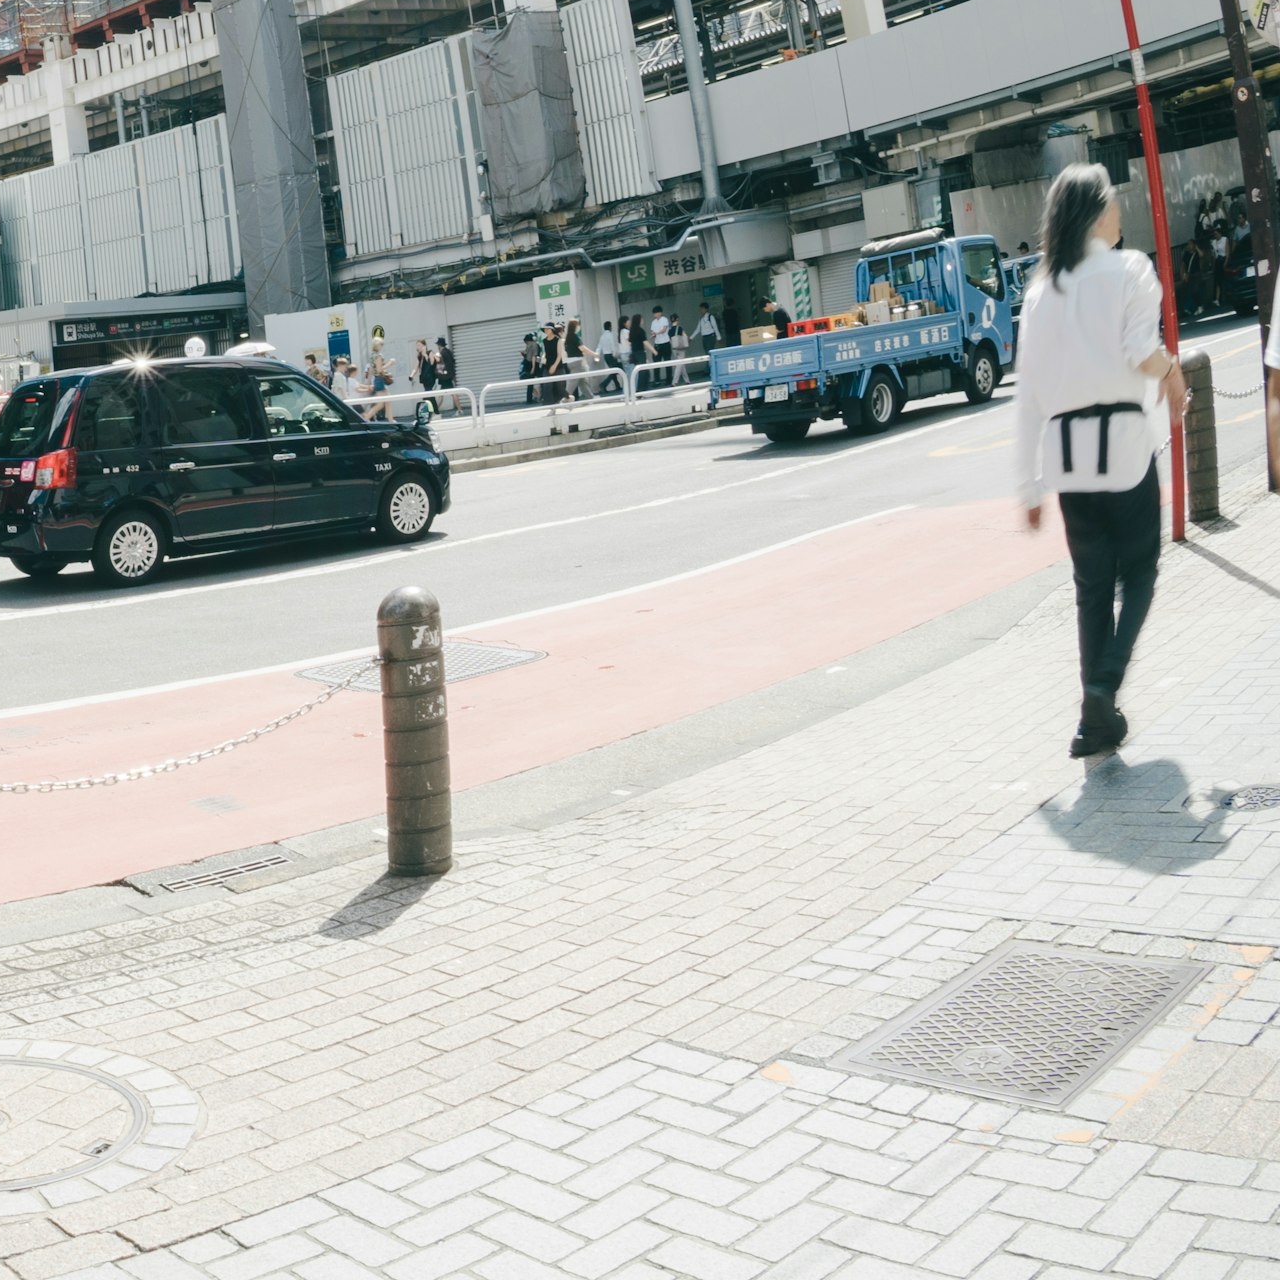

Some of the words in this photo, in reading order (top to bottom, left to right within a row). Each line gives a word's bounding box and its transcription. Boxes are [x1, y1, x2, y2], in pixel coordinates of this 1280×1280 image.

[627, 264, 648, 279] JR
[548, 284, 560, 295] JR
[125, 464, 140, 473] 432
[374, 463, 392, 472] TAXI
